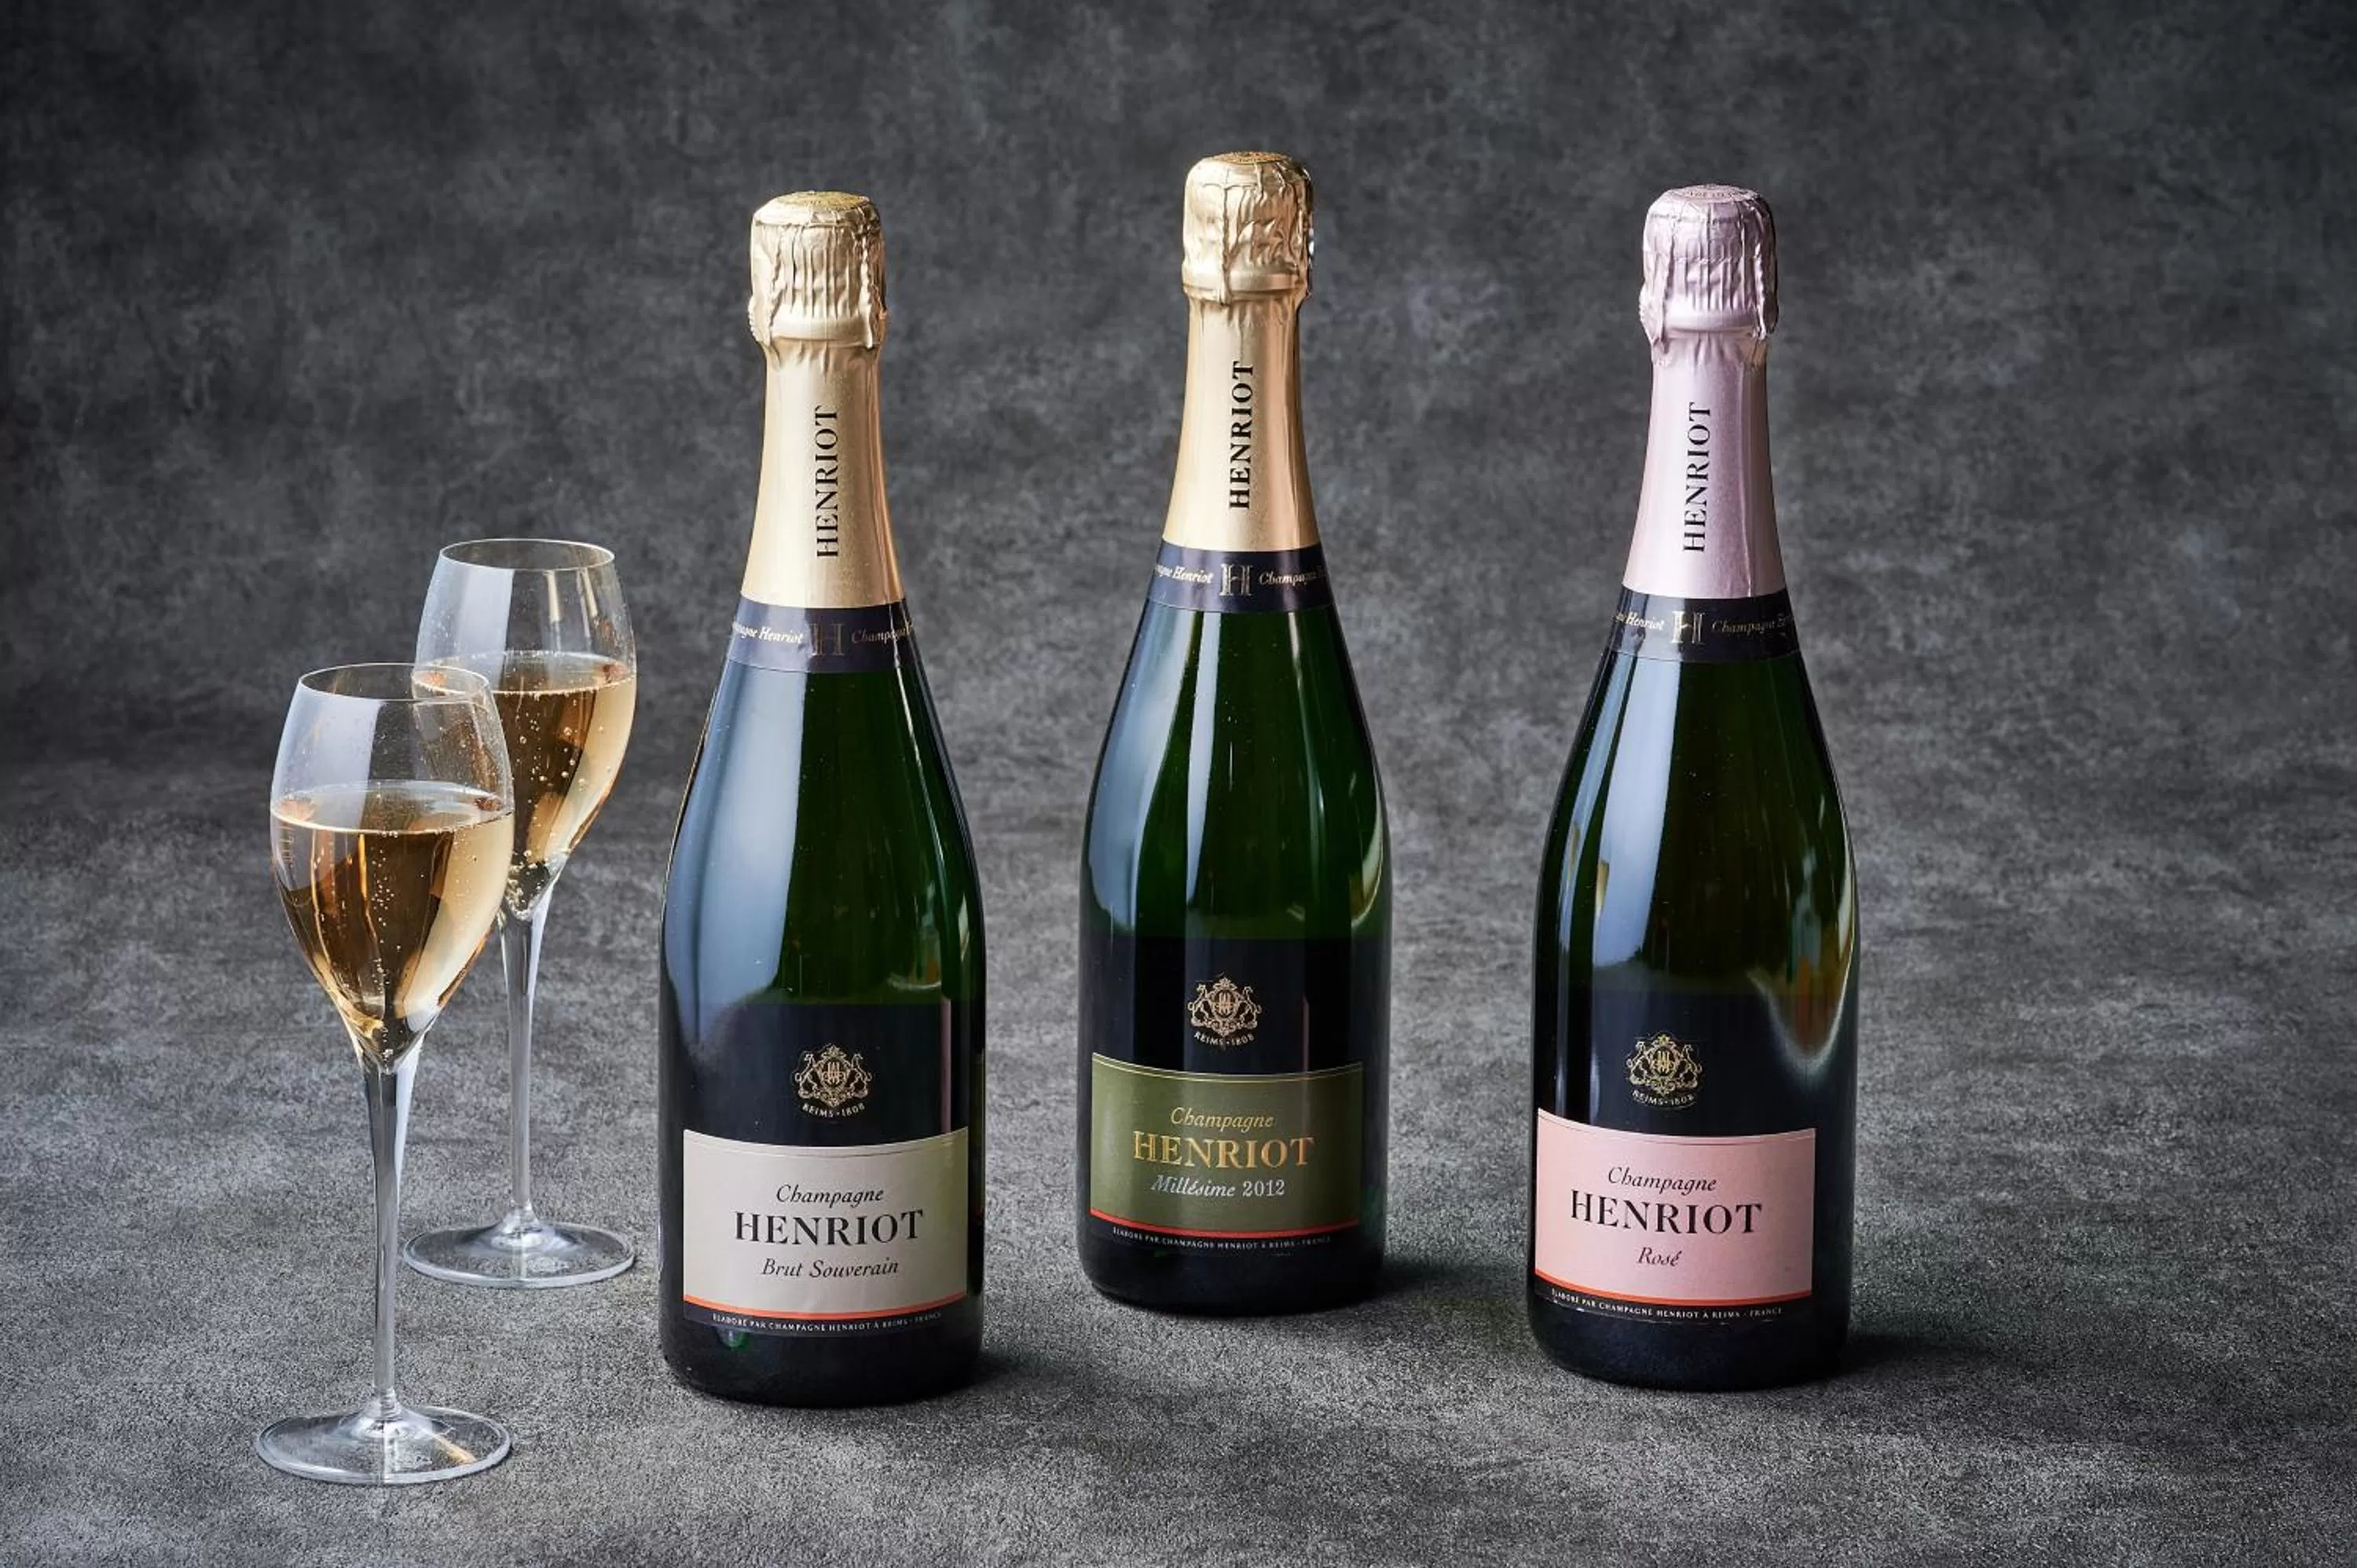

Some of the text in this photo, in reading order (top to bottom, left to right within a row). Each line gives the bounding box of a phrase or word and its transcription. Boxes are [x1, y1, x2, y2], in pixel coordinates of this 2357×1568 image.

[1229, 361, 1253, 510] HENRIOT
[815, 405, 838, 557] HENRIOT
[1683, 401, 1710, 552] HENRIOT
[1171, 566, 1214, 584] Henriot
[1219, 563, 1253, 597] H
[758, 625, 803, 644] Henriot
[1670, 610, 1705, 645] H
[802, 1102, 834, 1117] REIMS
[1170, 1107, 1275, 1133] Champagne
[1133, 1130, 1315, 1170] HENRIOT
[1150, 1174, 1285, 1198] Millésime 2012
[1607, 1166, 1717, 1196] Champagne
[775, 1184, 884, 1209] Champagne
[1571, 1189, 1763, 1235] HENRIOT
[735, 1209, 925, 1246] HENRIOT
[1163, 1237, 1215, 1248] CHAMPAGNE
[1217, 1241, 1258, 1250] HENRIOT
[761, 1257, 900, 1278] Brut Souverain
[1636, 1247, 1683, 1267] Rosé
[1582, 1299, 1596, 1307] PAR
[1600, 1302, 1653, 1316] CHAMPAGNE
[1657, 1310, 1699, 1319] HENRIOT
[750, 1320, 767, 1329] PAR
[768, 1321, 826, 1332] CHAMPAGNE
[829, 1321, 871, 1332] HENRIOT
